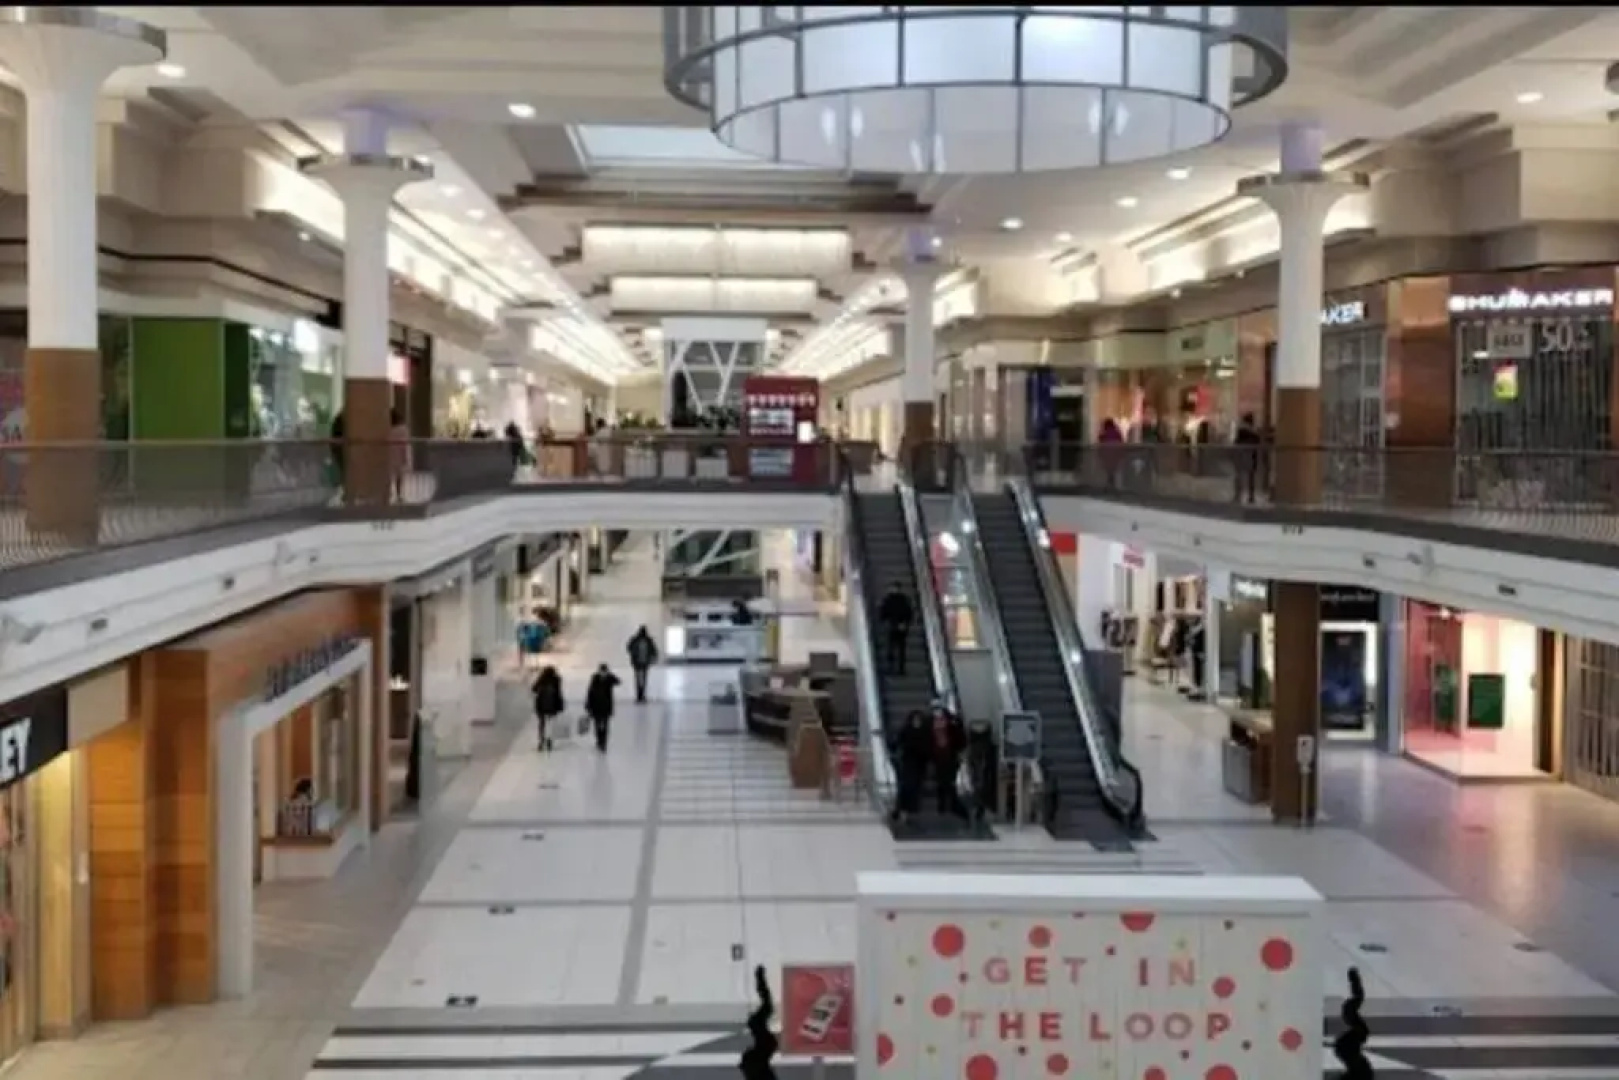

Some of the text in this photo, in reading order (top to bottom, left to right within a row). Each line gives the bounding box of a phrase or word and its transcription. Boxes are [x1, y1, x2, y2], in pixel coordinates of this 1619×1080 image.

[983, 956, 1196, 987] GET IN
[960, 1011, 1231, 1040] THE LOOP
